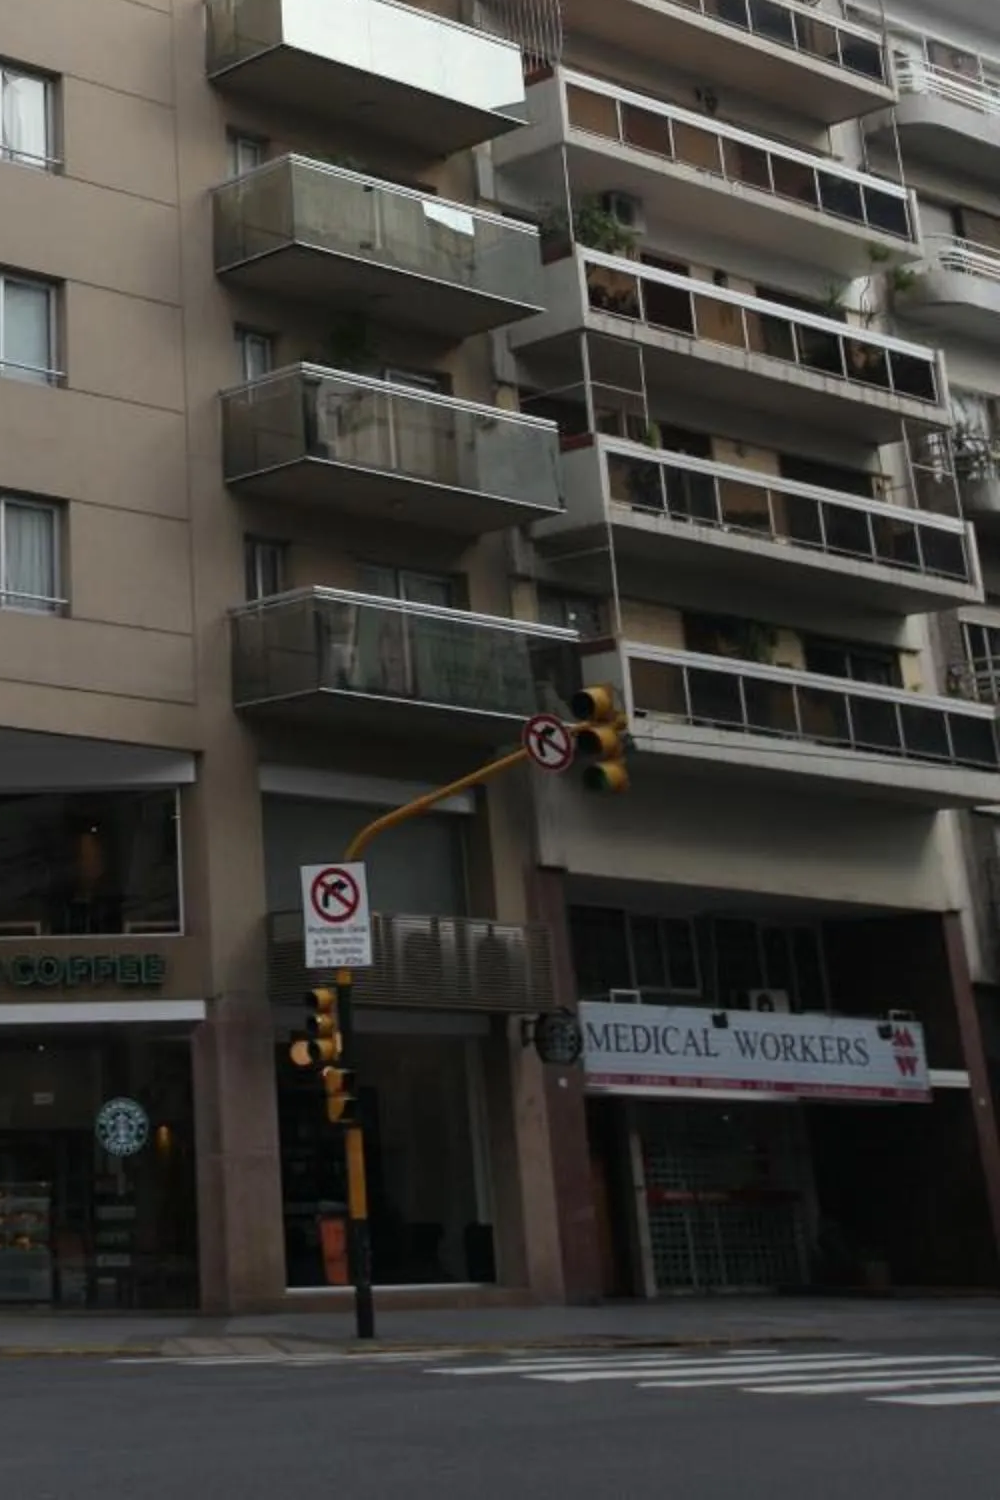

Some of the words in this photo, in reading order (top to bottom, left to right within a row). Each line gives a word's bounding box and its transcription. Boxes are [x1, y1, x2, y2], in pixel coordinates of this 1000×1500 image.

[9, 953, 167, 986] COFFEE
[585, 1021, 721, 1058] MEDICAL
[732, 1030, 871, 1068] WORKERS
